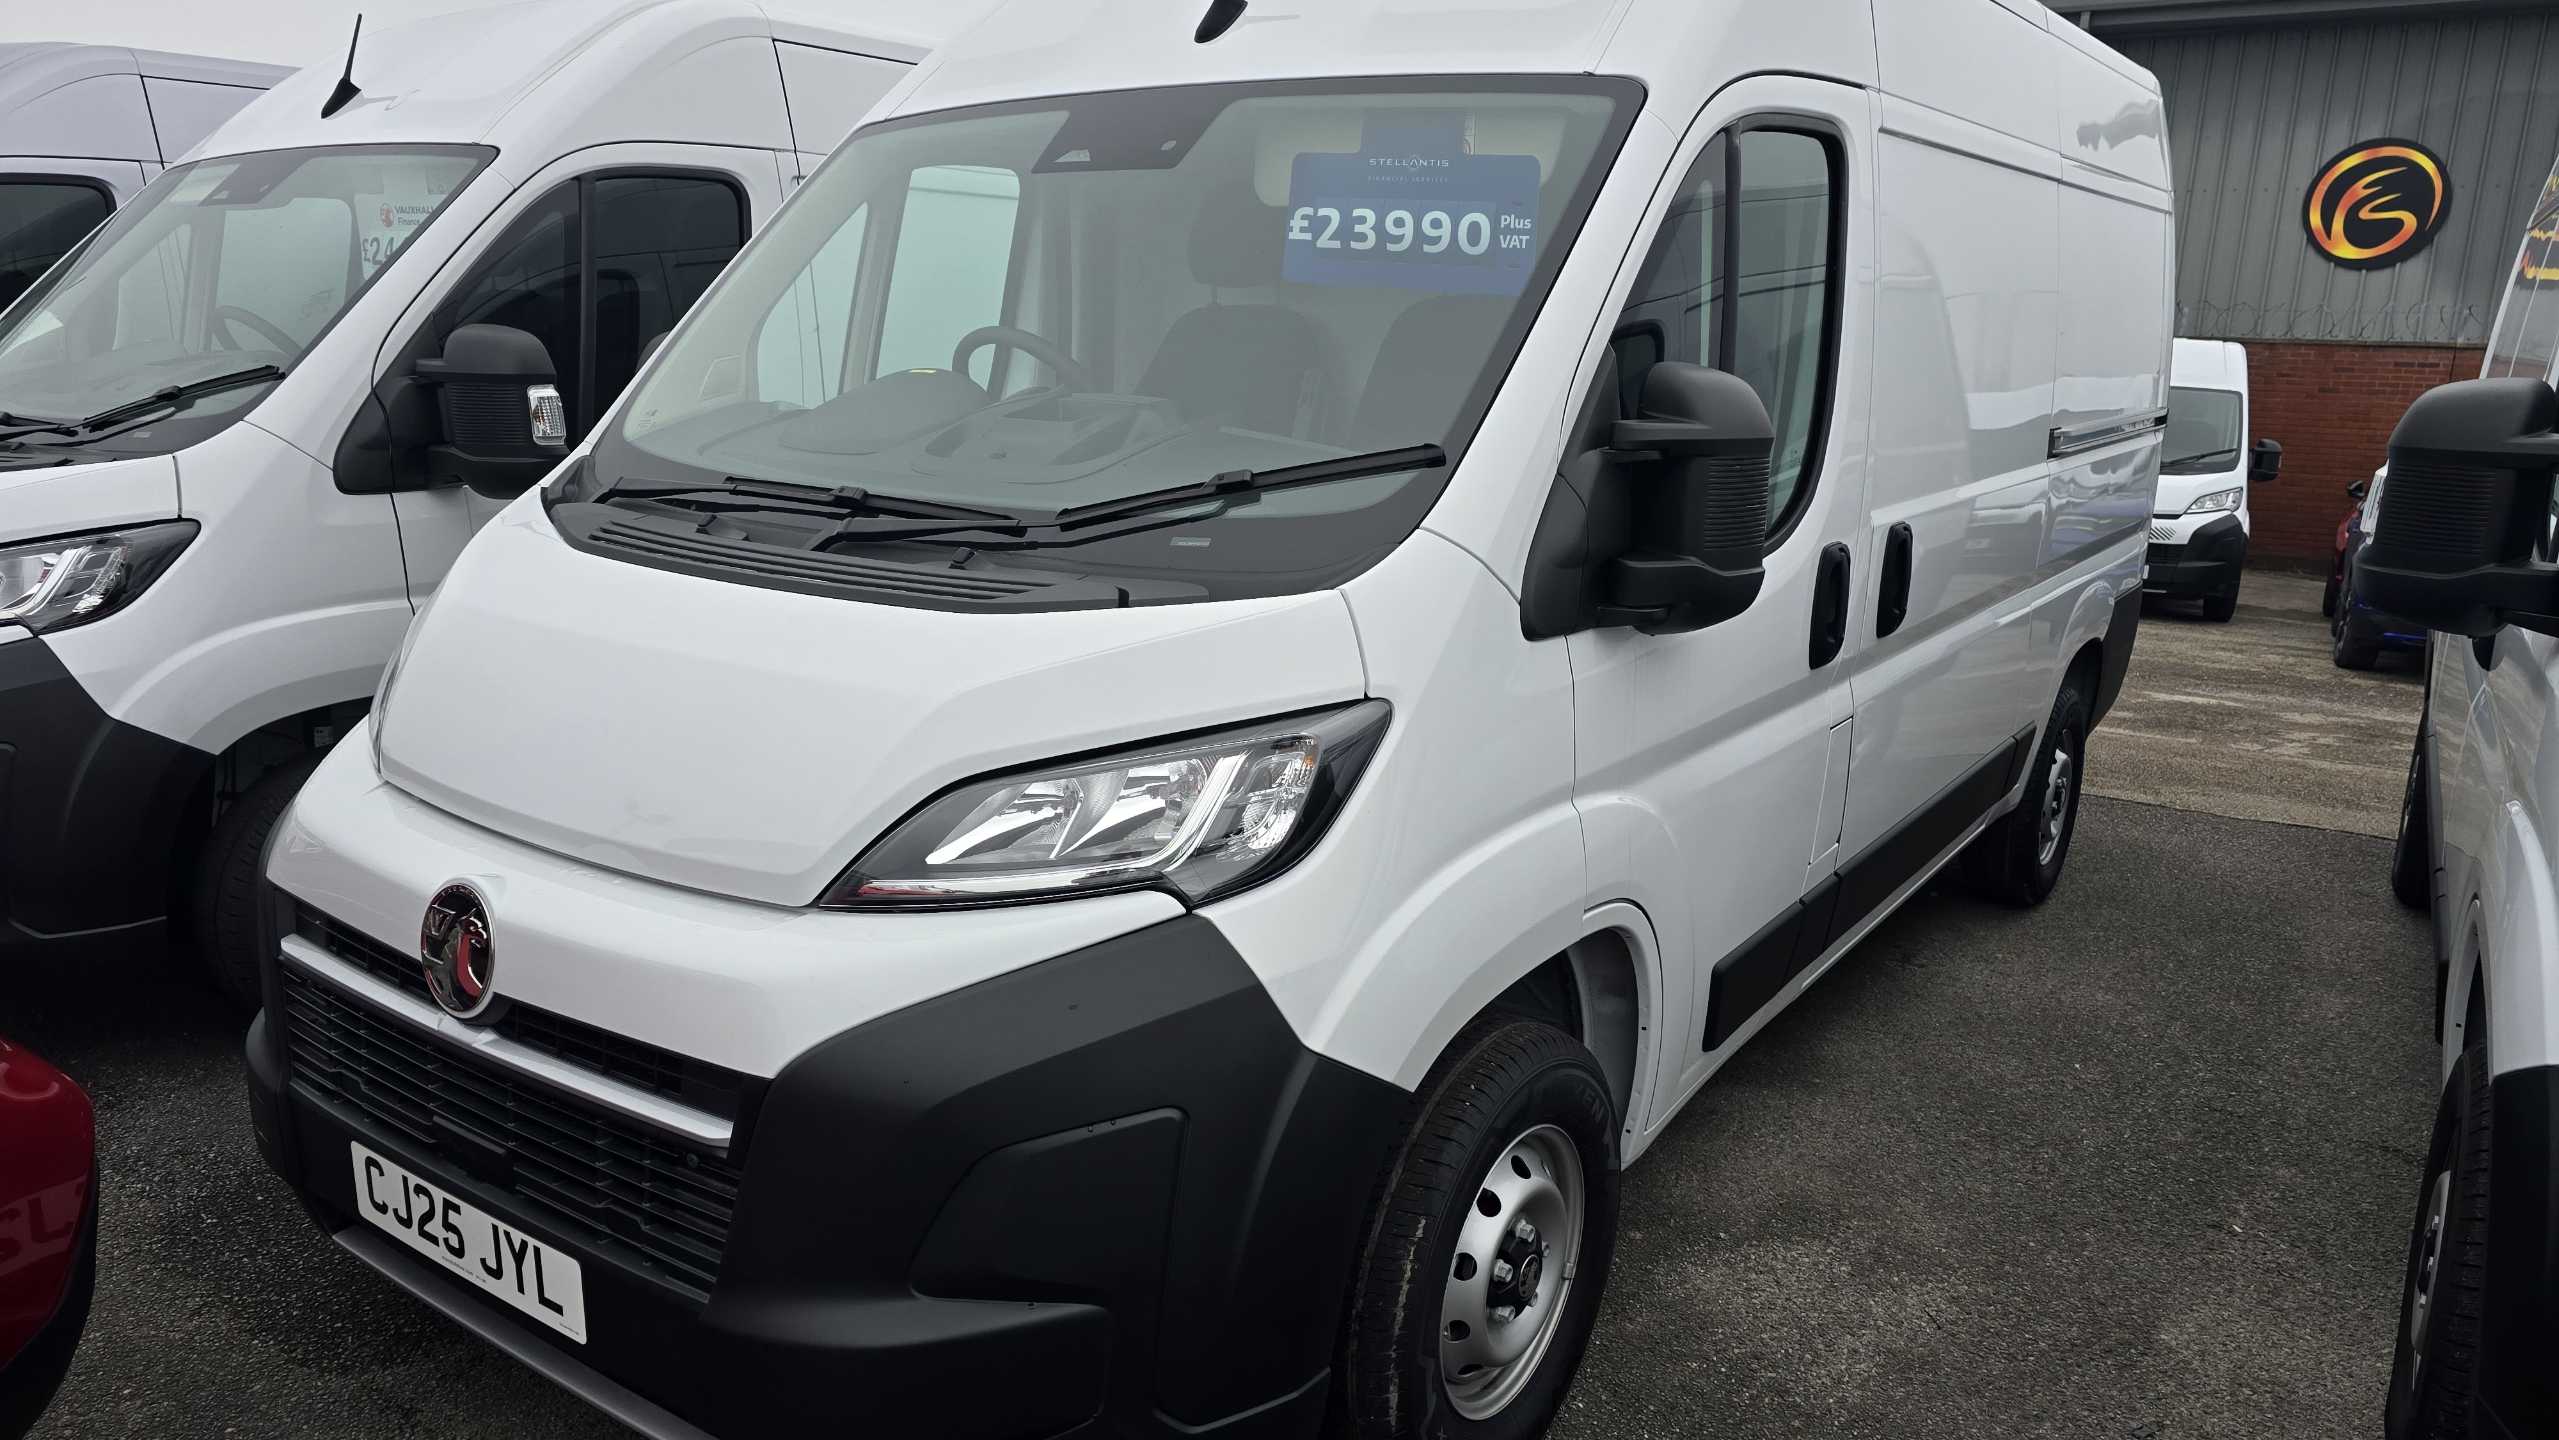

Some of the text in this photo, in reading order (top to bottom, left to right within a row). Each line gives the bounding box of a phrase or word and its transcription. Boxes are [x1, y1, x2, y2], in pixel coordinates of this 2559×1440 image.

[1368, 157, 1449, 167] STELLANTIS
[1288, 206, 1491, 256] £23990
[1501, 214, 1532, 230] Plus
[362, 236, 399, 266] £24
[1500, 235, 1530, 249] VAT
[365, 1155, 564, 1318] CJ25 JYL
